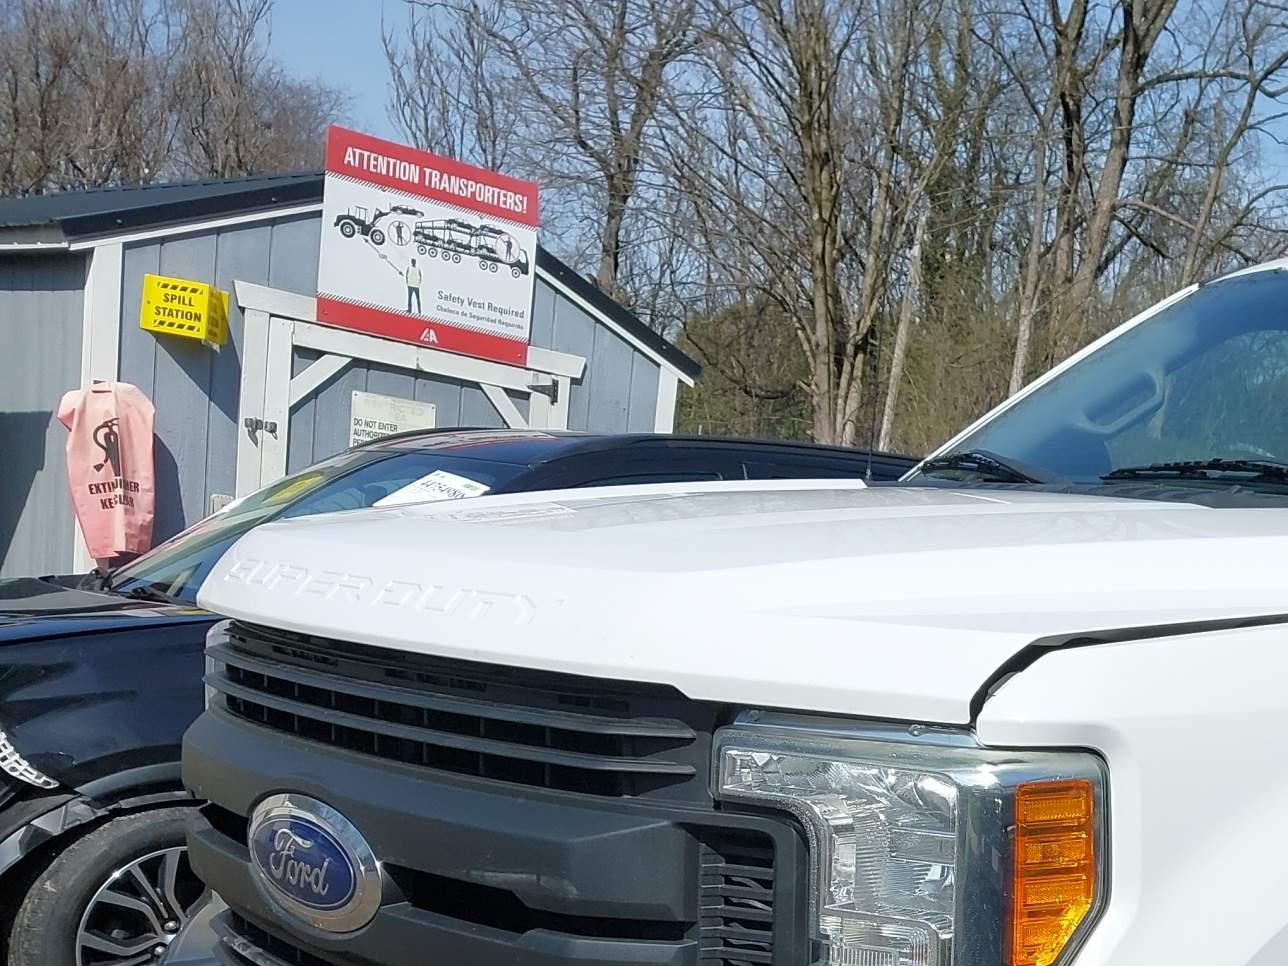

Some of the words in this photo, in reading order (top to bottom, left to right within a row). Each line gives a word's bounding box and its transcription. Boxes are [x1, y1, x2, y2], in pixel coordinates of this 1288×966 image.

[344, 147, 419, 184] ATTENTION
[423, 167, 527, 214] TRANSPORTERS!
[154, 305, 202, 323] STATION
[163, 293, 195, 307] SPILL
[437, 290, 464, 307] Safety
[467, 297, 485, 310] Vest
[488, 302, 525, 319] Required
[353, 417, 363, 427] DO
[364, 419, 377, 429] NOT
[378, 422, 398, 432] ENTER
[224, 558, 373, 601] SUPER
[371, 579, 538, 625] DUTY
[269, 829, 330, 897] Ford
